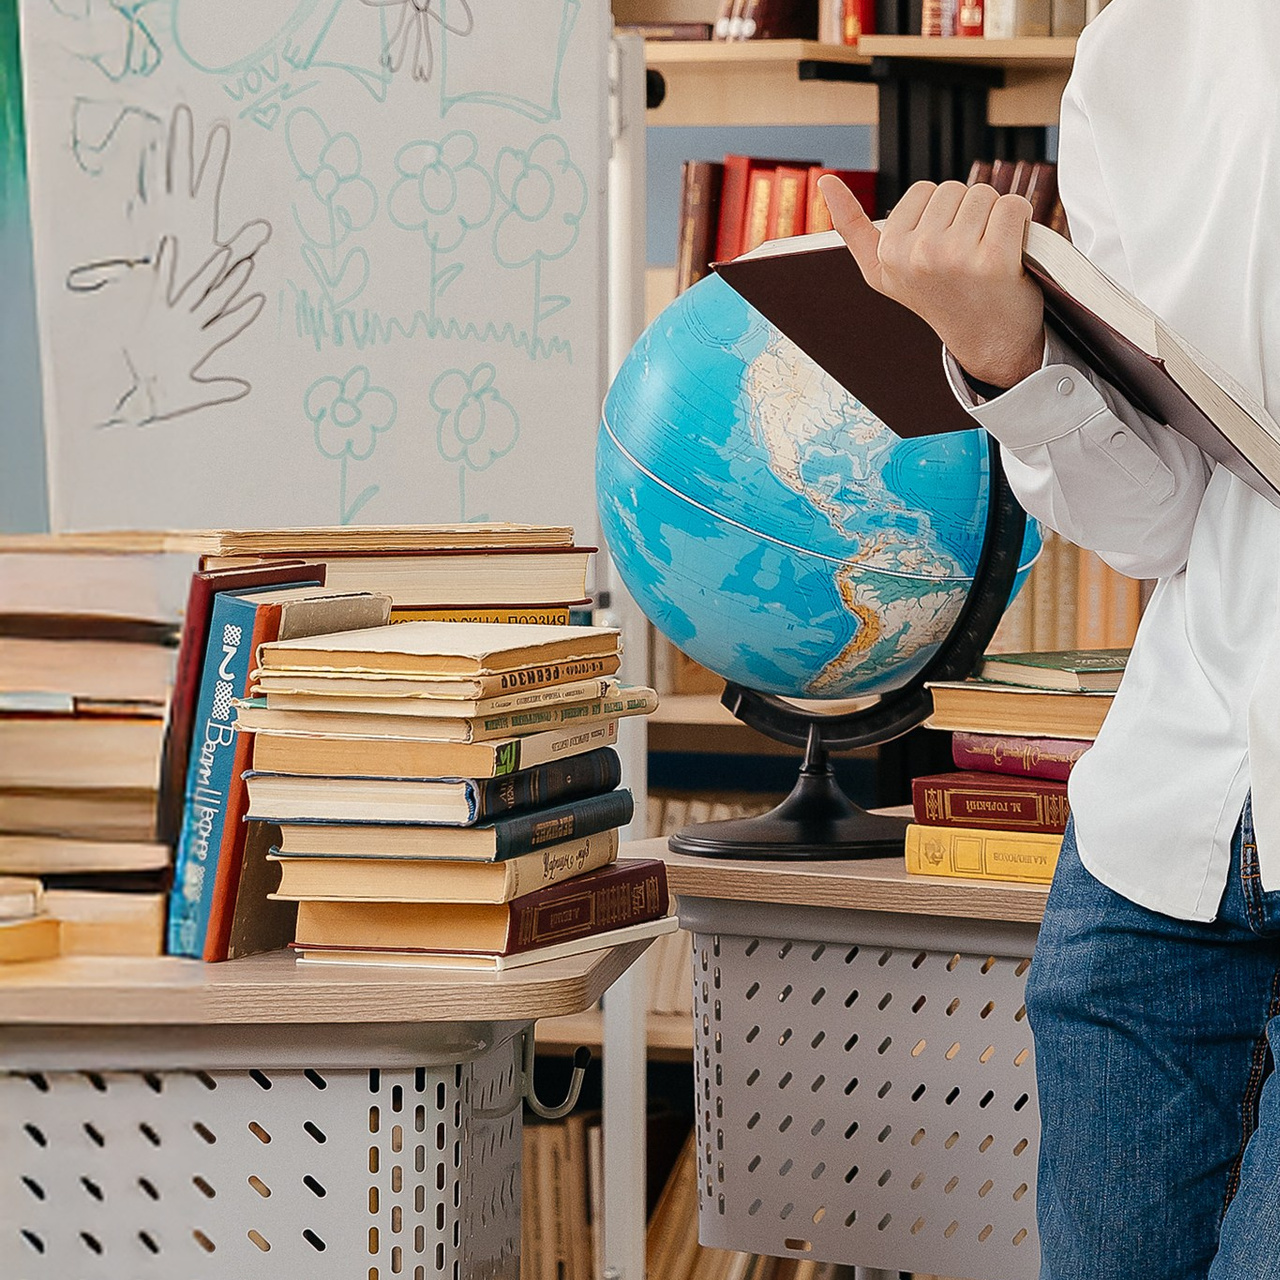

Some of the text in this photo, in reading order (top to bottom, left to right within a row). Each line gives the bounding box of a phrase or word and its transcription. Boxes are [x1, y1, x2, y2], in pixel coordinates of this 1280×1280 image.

[501, 666, 560, 689] РЕВИЗОР
[198, 718, 235, 786] Вадим
[965, 799, 1022, 813] М. ГОРЬКИЙ
